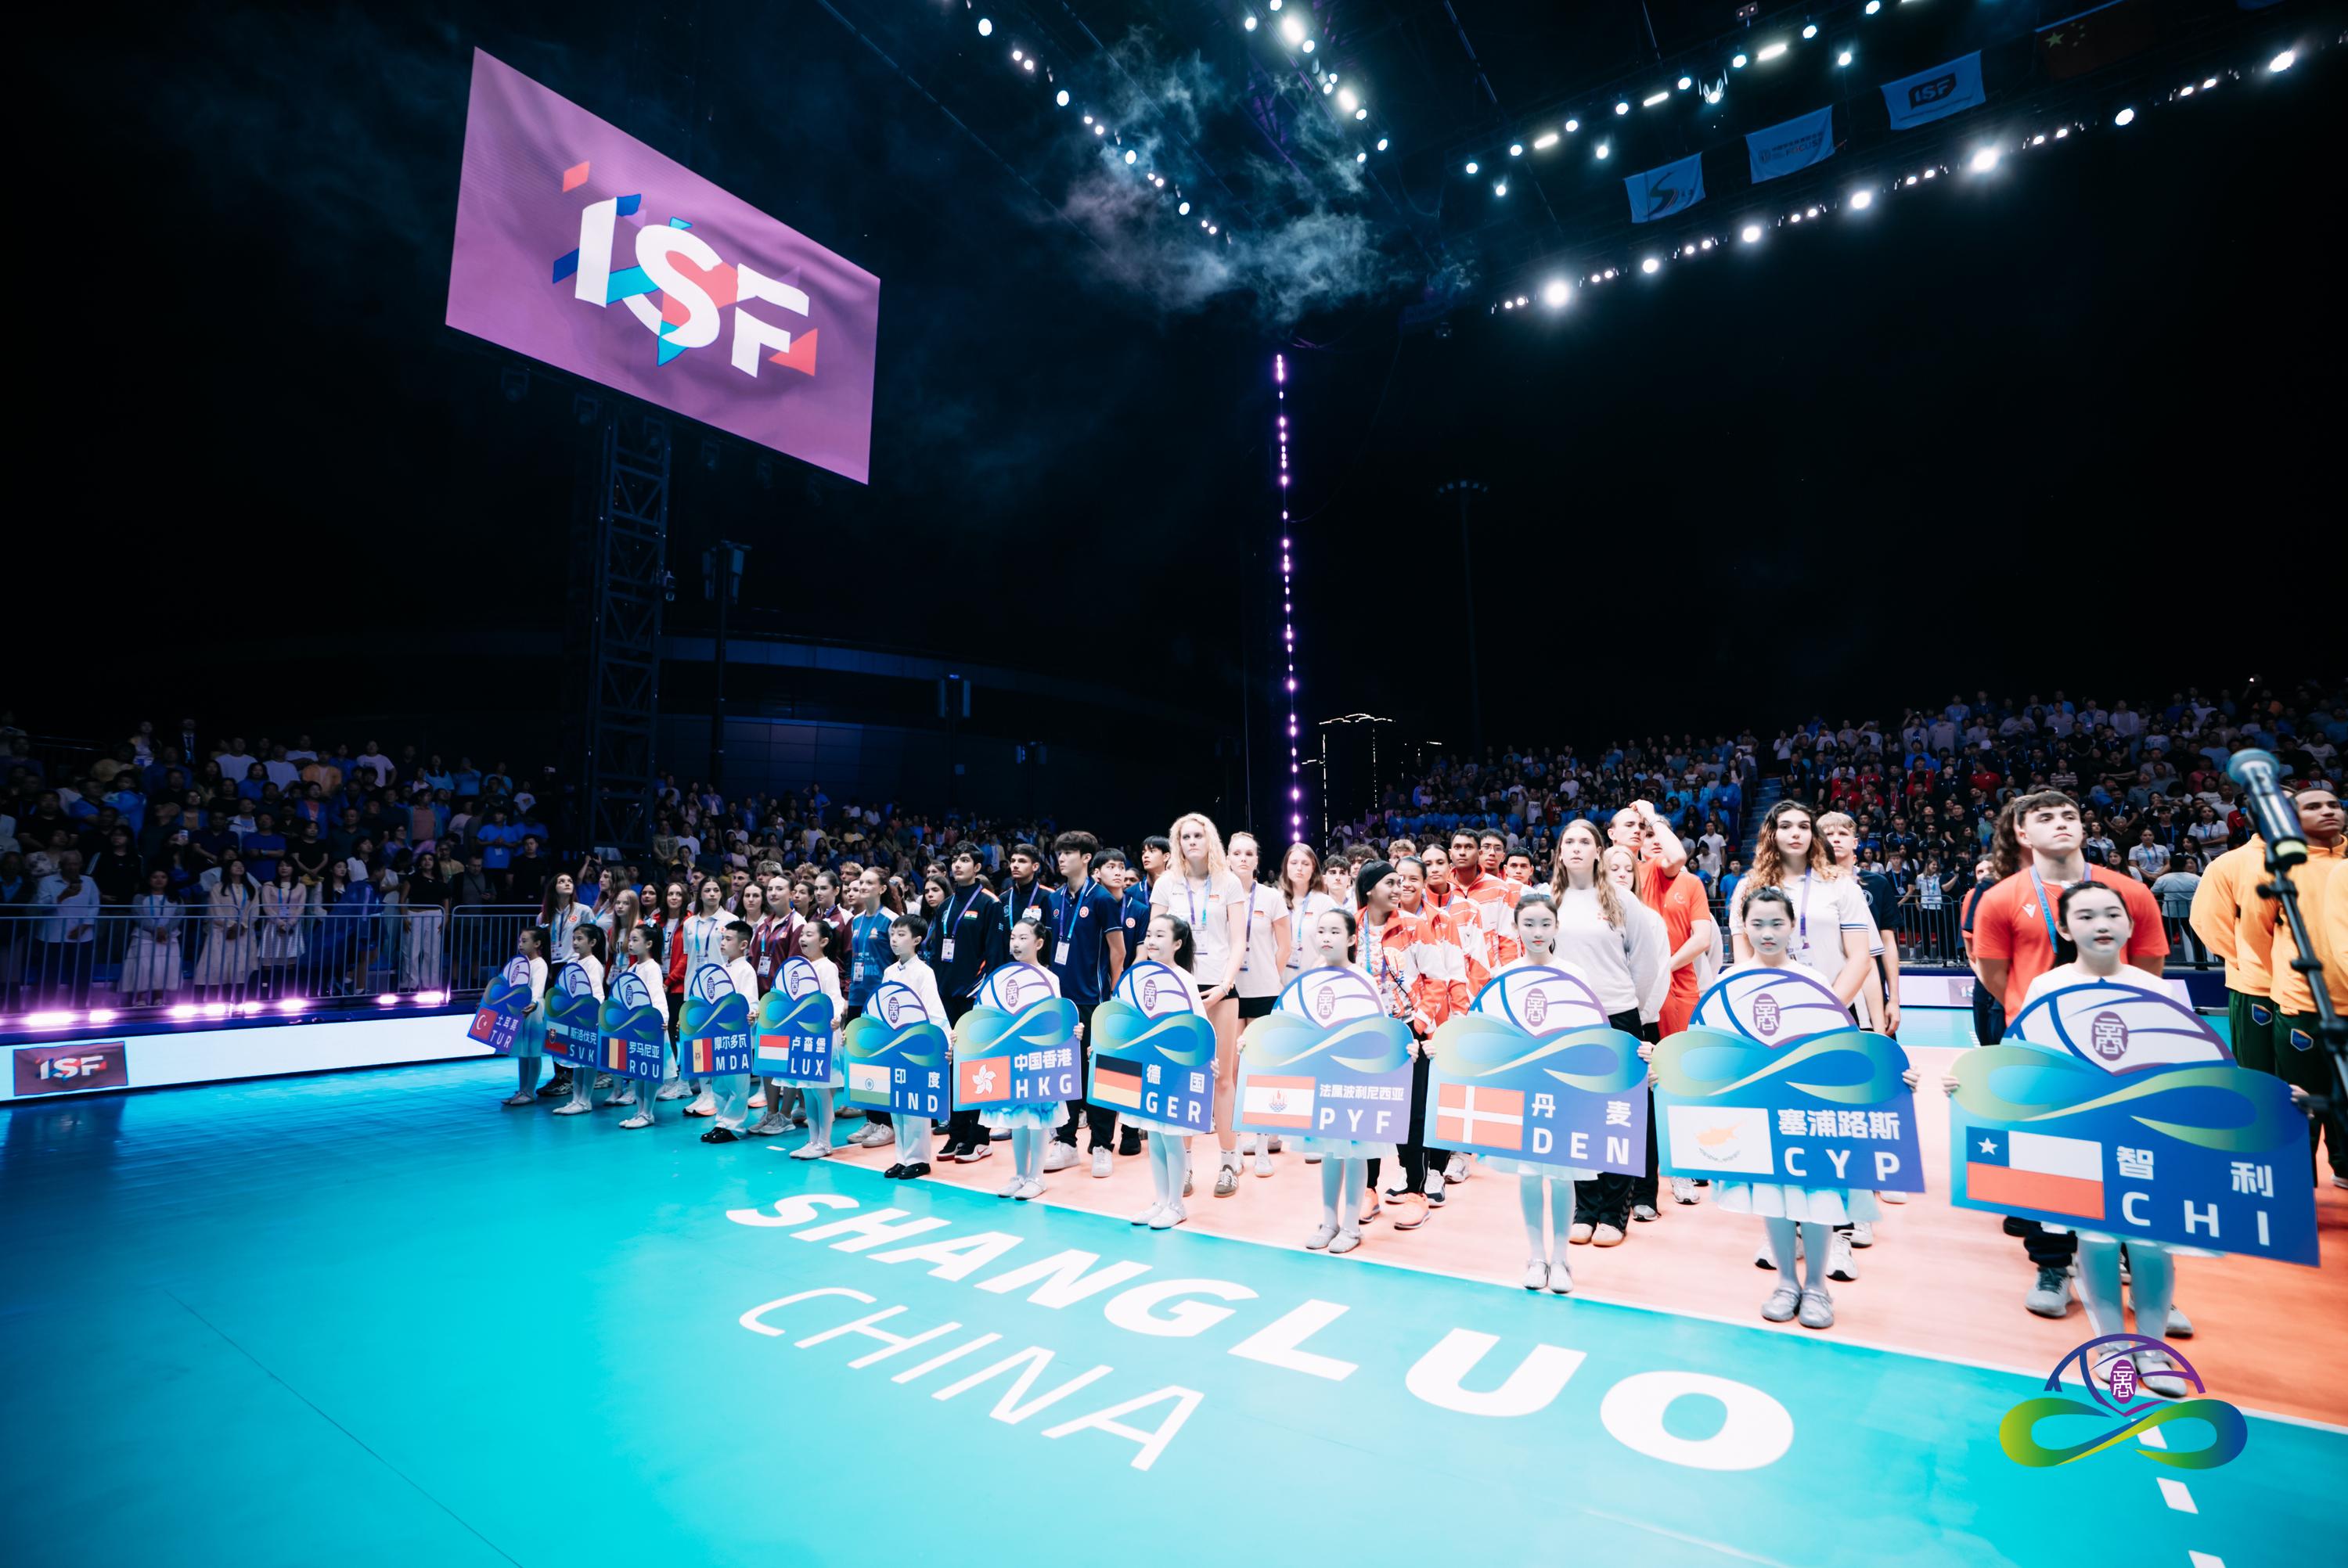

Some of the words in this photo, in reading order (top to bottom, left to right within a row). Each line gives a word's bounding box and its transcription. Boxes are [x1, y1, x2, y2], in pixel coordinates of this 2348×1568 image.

[1914, 78, 1951, 102] ISF
[574, 196, 809, 378] ISF
[489, 1029, 512, 1048] TUR
[570, 1027, 597, 1045] 斯洛伐克
[714, 1034, 747, 1051] 摩尔多瓦
[791, 1036, 826, 1053] 卢森堡
[569, 1044, 595, 1063] SVK
[629, 1041, 660, 1059] 罗马尼亚
[715, 1053, 749, 1071] MDA
[1014, 1048, 1072, 1072] 中国香港
[40, 1056, 104, 1081] ISF
[629, 1059, 660, 1078] ROU
[790, 1057, 824, 1077] LUX
[895, 1068, 940, 1089] 印度
[1146, 1063, 1205, 1094] 德国
[1016, 1074, 1072, 1099] HKG
[1320, 1084, 1405, 1102] 法属波利尼西亚
[895, 1091, 938, 1113] IND
[1145, 1091, 1201, 1124] GER
[1532, 1093, 1632, 1128] 丹麦
[1319, 1107, 1392, 1135] PYF
[1777, 1109, 1900, 1140] 塞浦路斯
[1532, 1127, 1630, 1166] DEN
[1784, 1147, 1900, 1181] CYP
[2116, 1145, 2274, 1198] 智利
[2122, 1191, 2271, 1246] CHI
[726, 1193, 1795, 1471] SHANGLUO
[739, 1287, 1205, 1471] CHINA
